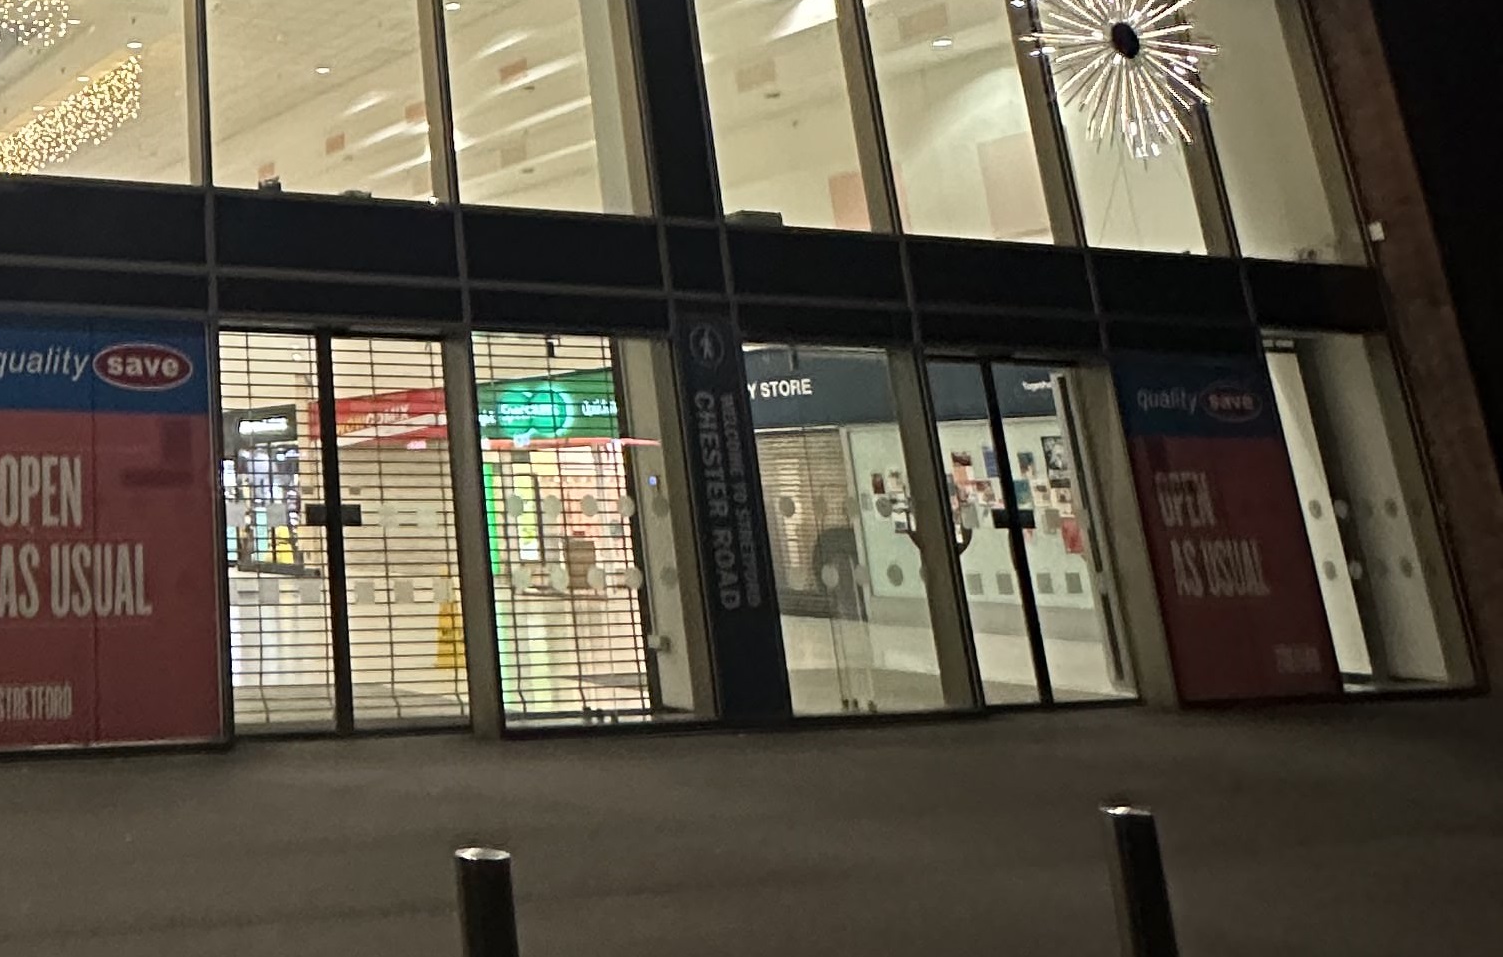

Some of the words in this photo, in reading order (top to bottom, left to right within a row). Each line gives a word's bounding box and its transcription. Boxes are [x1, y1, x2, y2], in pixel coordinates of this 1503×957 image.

[107, 355, 180, 379] save
[760, 378, 814, 399] STORE
[1136, 386, 1197, 415] quality
[1208, 392, 1255, 412] save
[694, 390, 730, 518] CHESTER
[712, 528, 742, 611] ROAD
[1154, 471, 1218, 529] OPEN
[48, 540, 154, 619] USUAL
[1169, 537, 1206, 599] AS
[1199, 536, 1272, 598] USUAL
